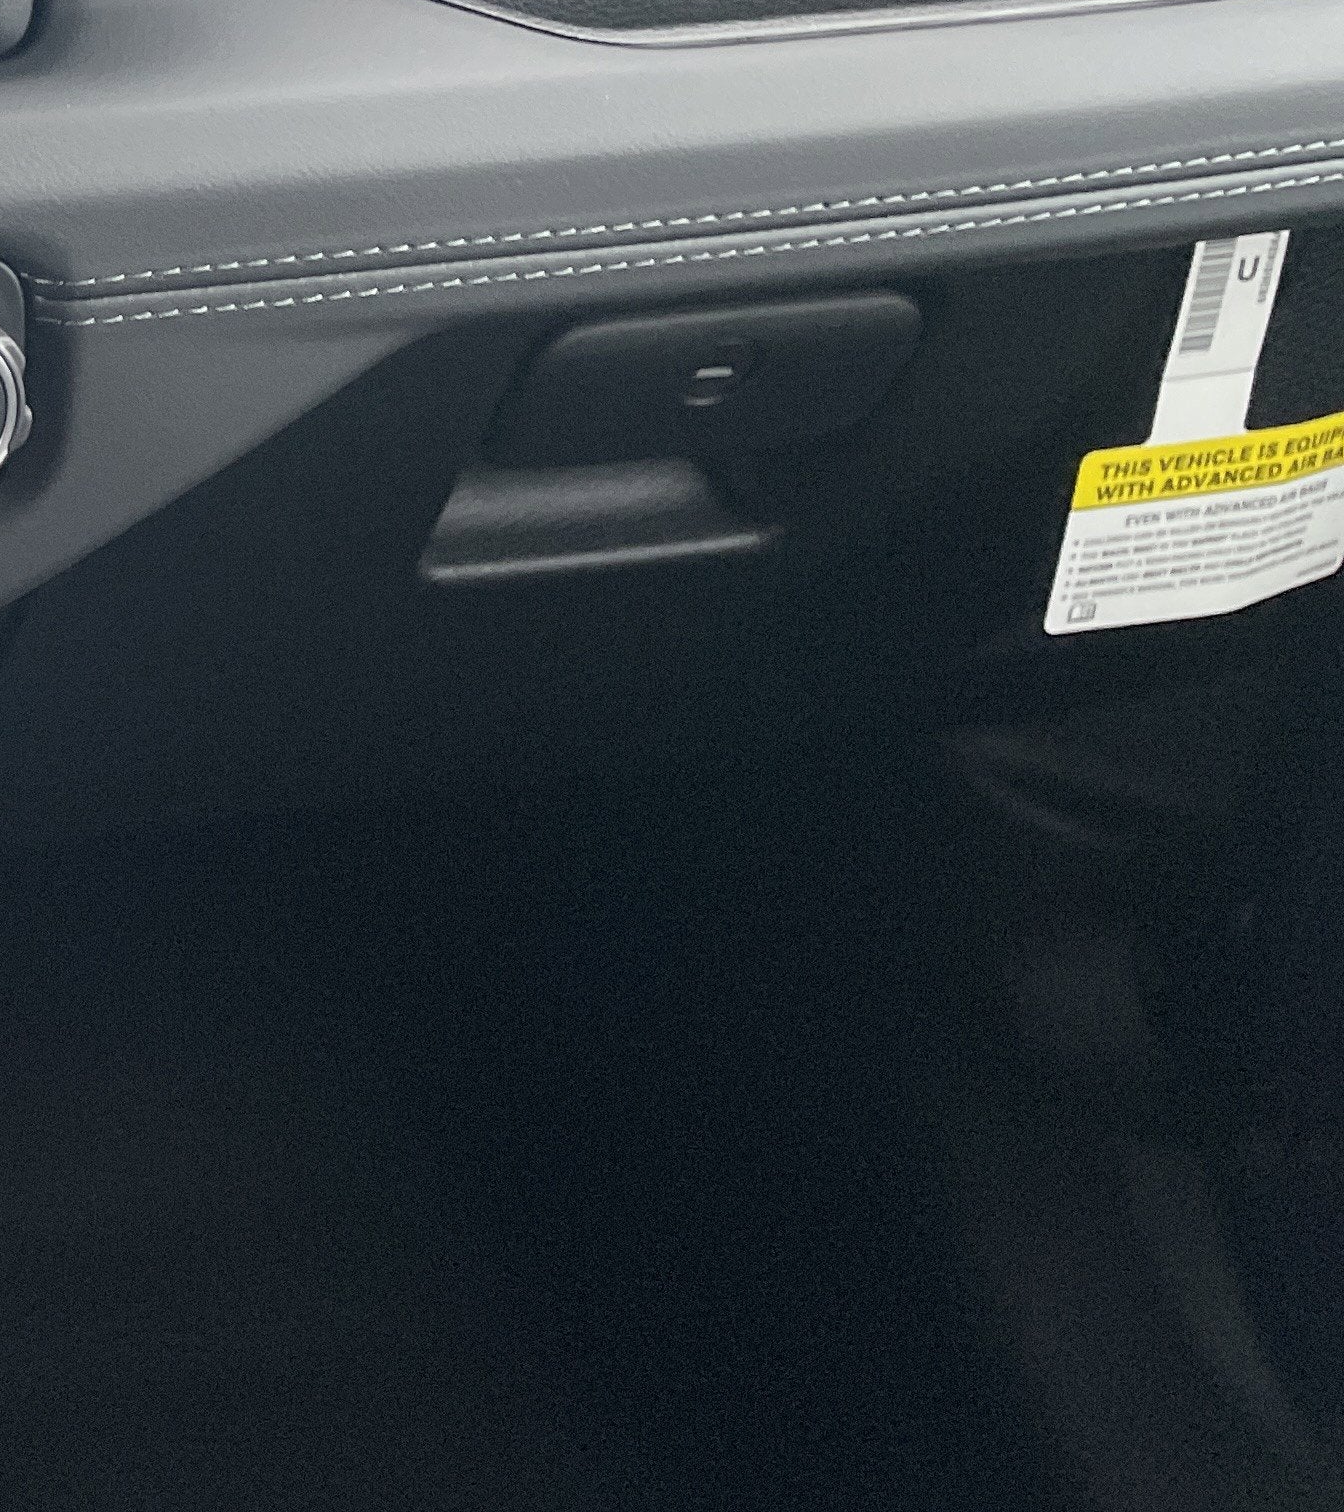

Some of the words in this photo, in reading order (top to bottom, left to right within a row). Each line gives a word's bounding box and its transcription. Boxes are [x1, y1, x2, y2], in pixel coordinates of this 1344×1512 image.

[1238, 256, 1260, 281] U
[1097, 481, 1154, 502] WITH
[1164, 466, 1282, 492] ADVANCED
[1287, 453, 1317, 477] AIR
[1102, 458, 1151, 481] THIS
[1160, 445, 1251, 471] VEHICLE
[1258, 441, 1278, 459] IS
